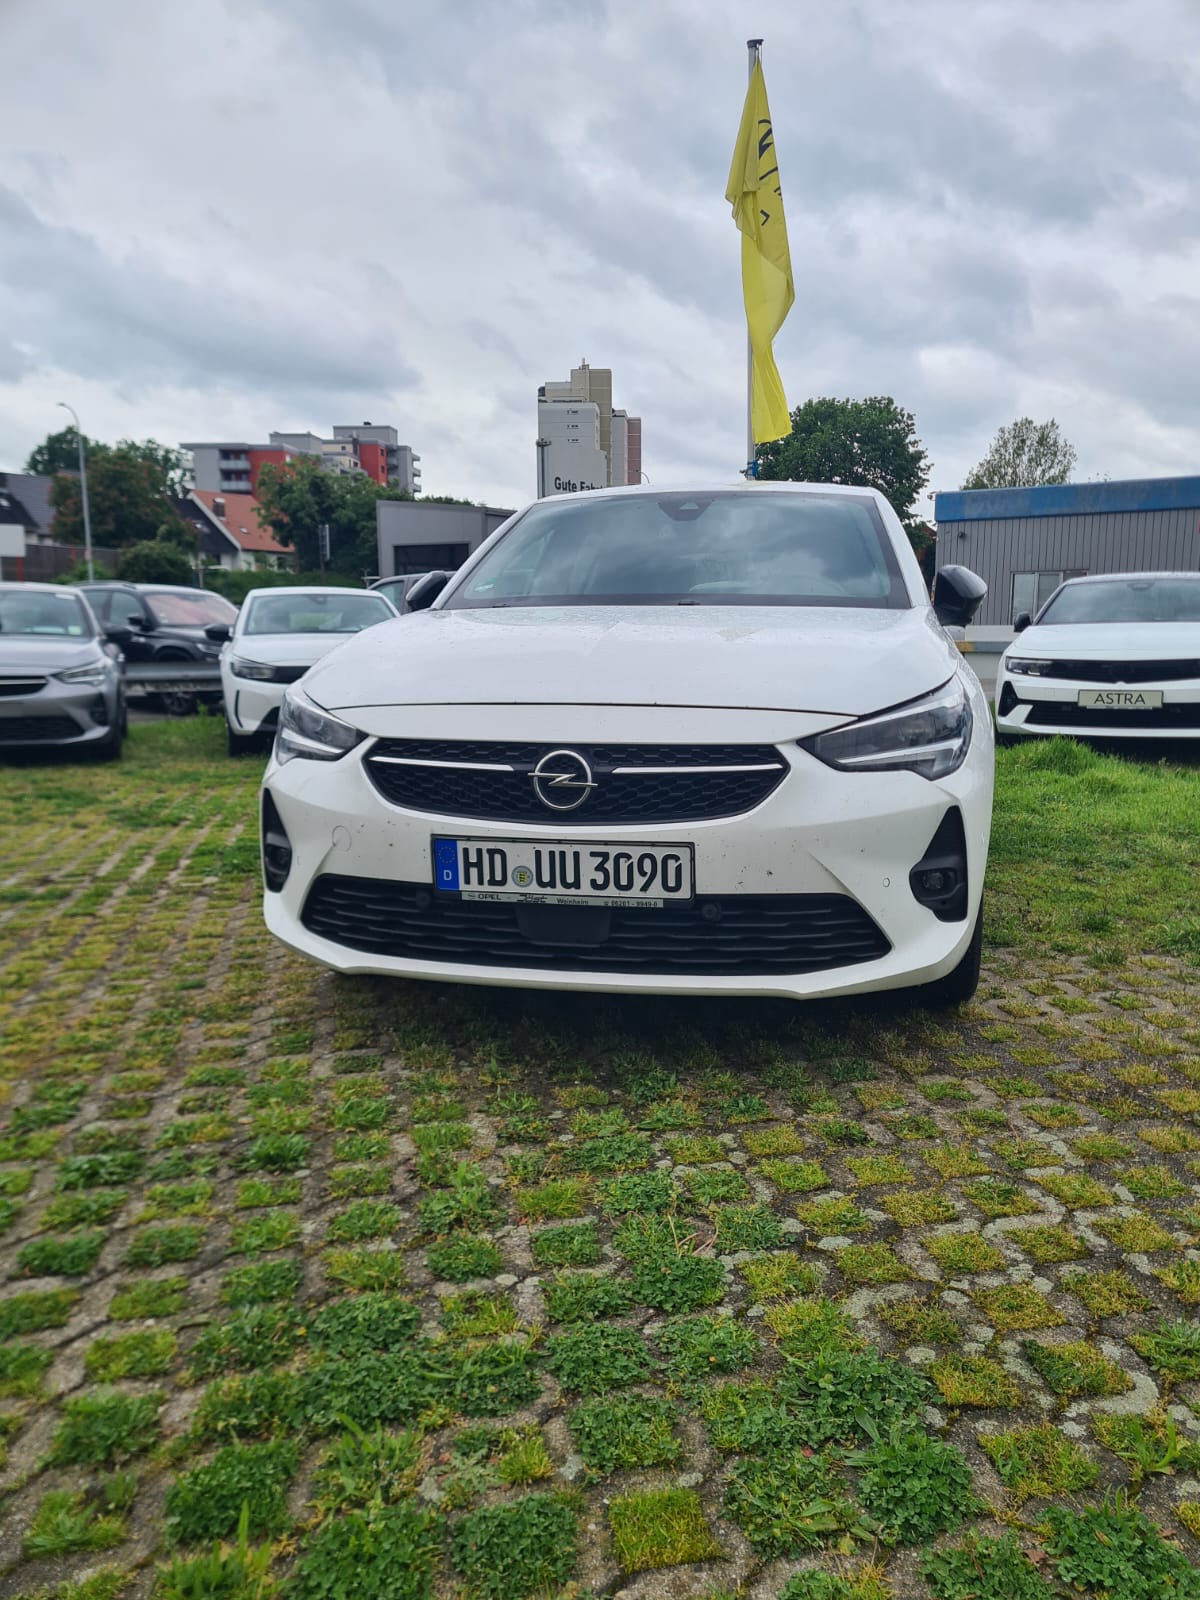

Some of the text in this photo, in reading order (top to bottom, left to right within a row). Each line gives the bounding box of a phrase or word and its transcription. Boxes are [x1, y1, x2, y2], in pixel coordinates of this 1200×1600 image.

[554, 476, 577, 492] Gute
[1094, 692, 1146, 704] ASTRA
[443, 869, 453, 881] D
[462, 847, 682, 893] HD UU 3090
[478, 893, 502, 901] OPEL
